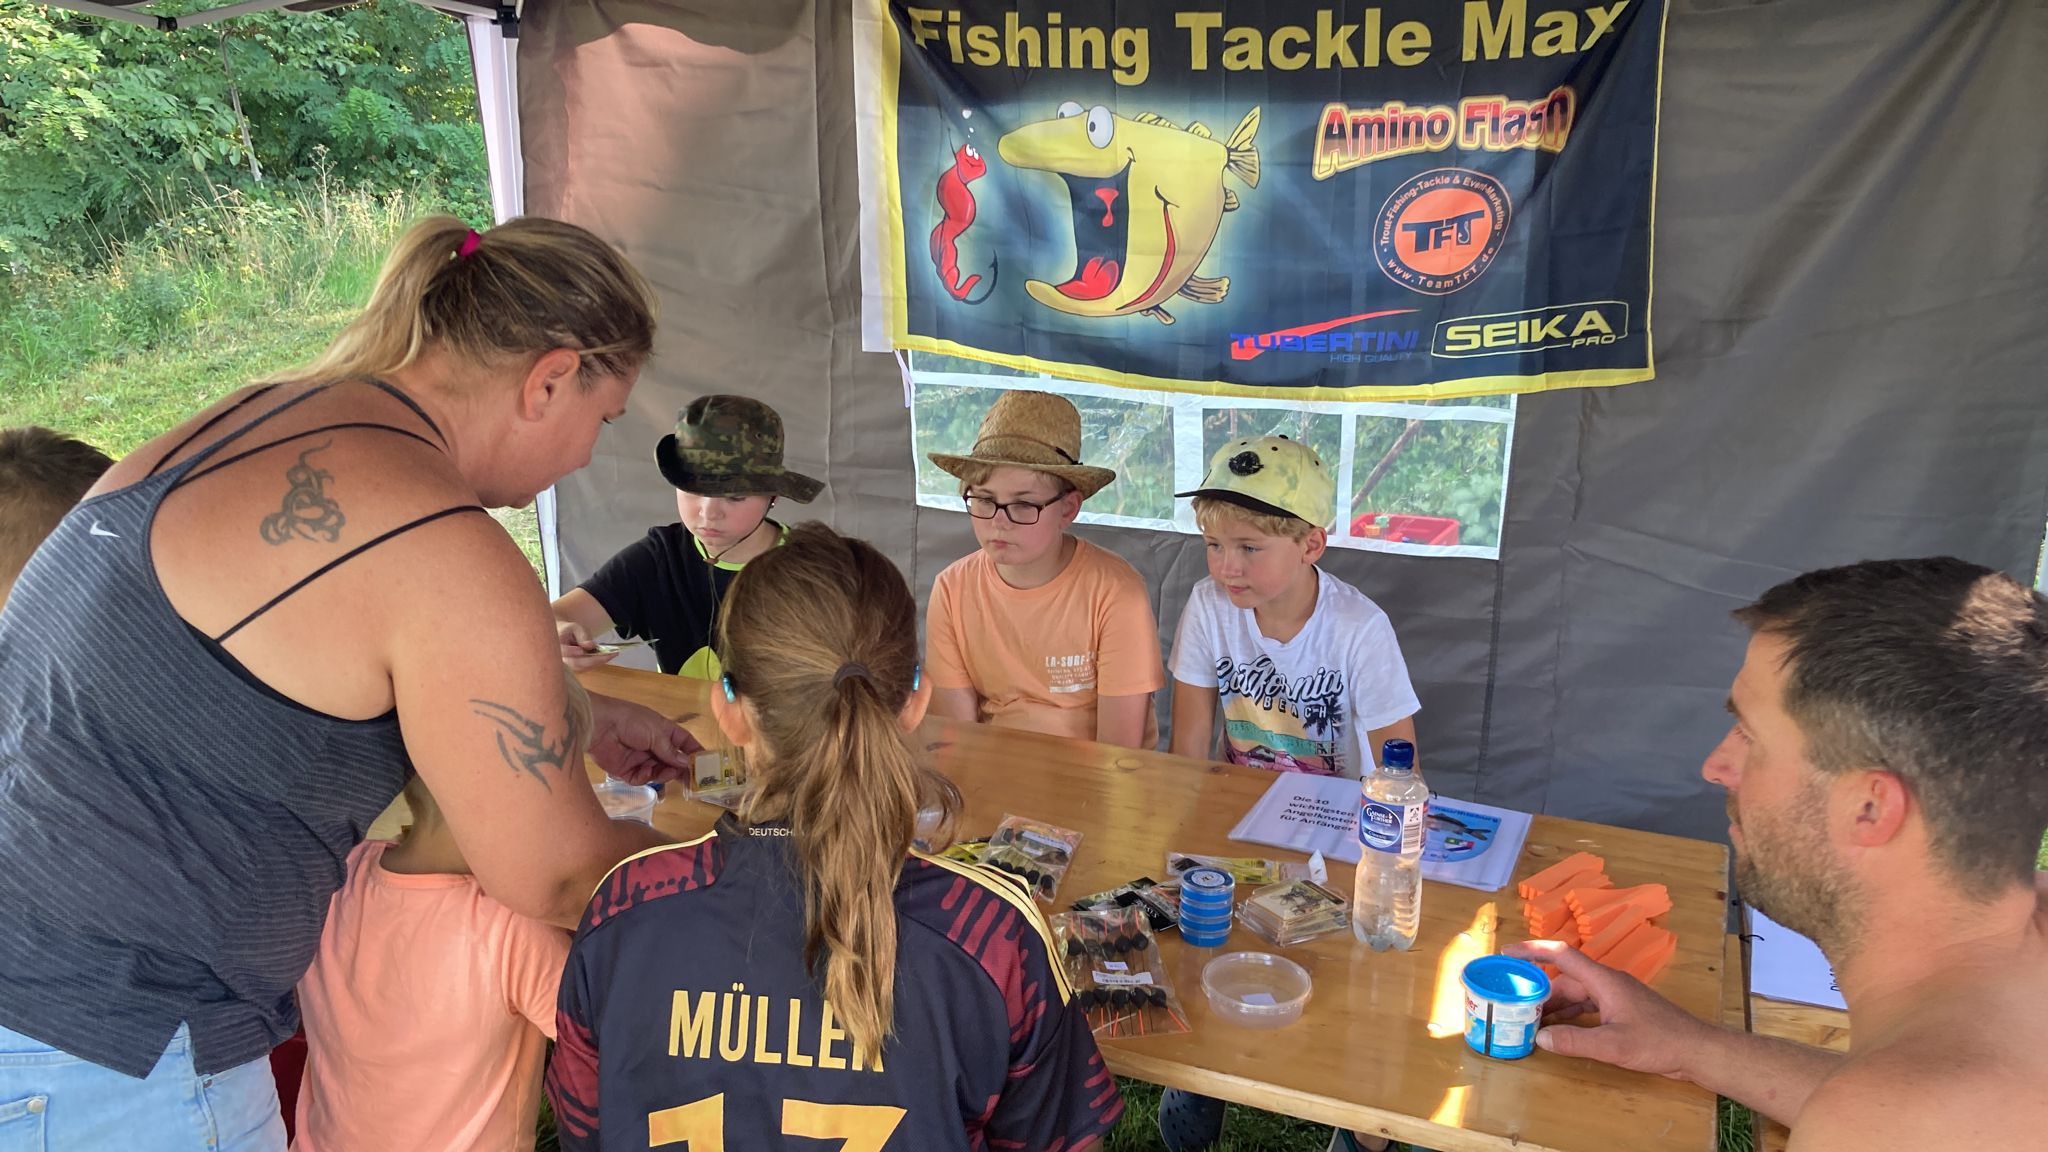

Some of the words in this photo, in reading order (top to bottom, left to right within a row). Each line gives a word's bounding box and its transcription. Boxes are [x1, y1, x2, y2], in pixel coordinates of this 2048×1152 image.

[908, 7, 1149, 86] Fishing
[1175, 8, 1432, 71] Tackle
[1461, 0, 1631, 62] Max
[1313, 103, 1454, 179] Amino
[1402, 210, 1485, 253] TFT
[1230, 330, 1420, 352] TUBERTINI
[1445, 310, 1612, 352] SEIKA
[1571, 334, 1616, 348] PRO
[1330, 353, 1361, 363] HIGH
[1364, 351, 1412, 363] QUALITY
[1216, 654, 1344, 705] California
[1263, 695, 1328, 718] BEACH
[1289, 803, 1355, 817] wichtigsten
[749, 827, 797, 837] DEUTSCH
[1299, 817, 1354, 831] Anfänger
